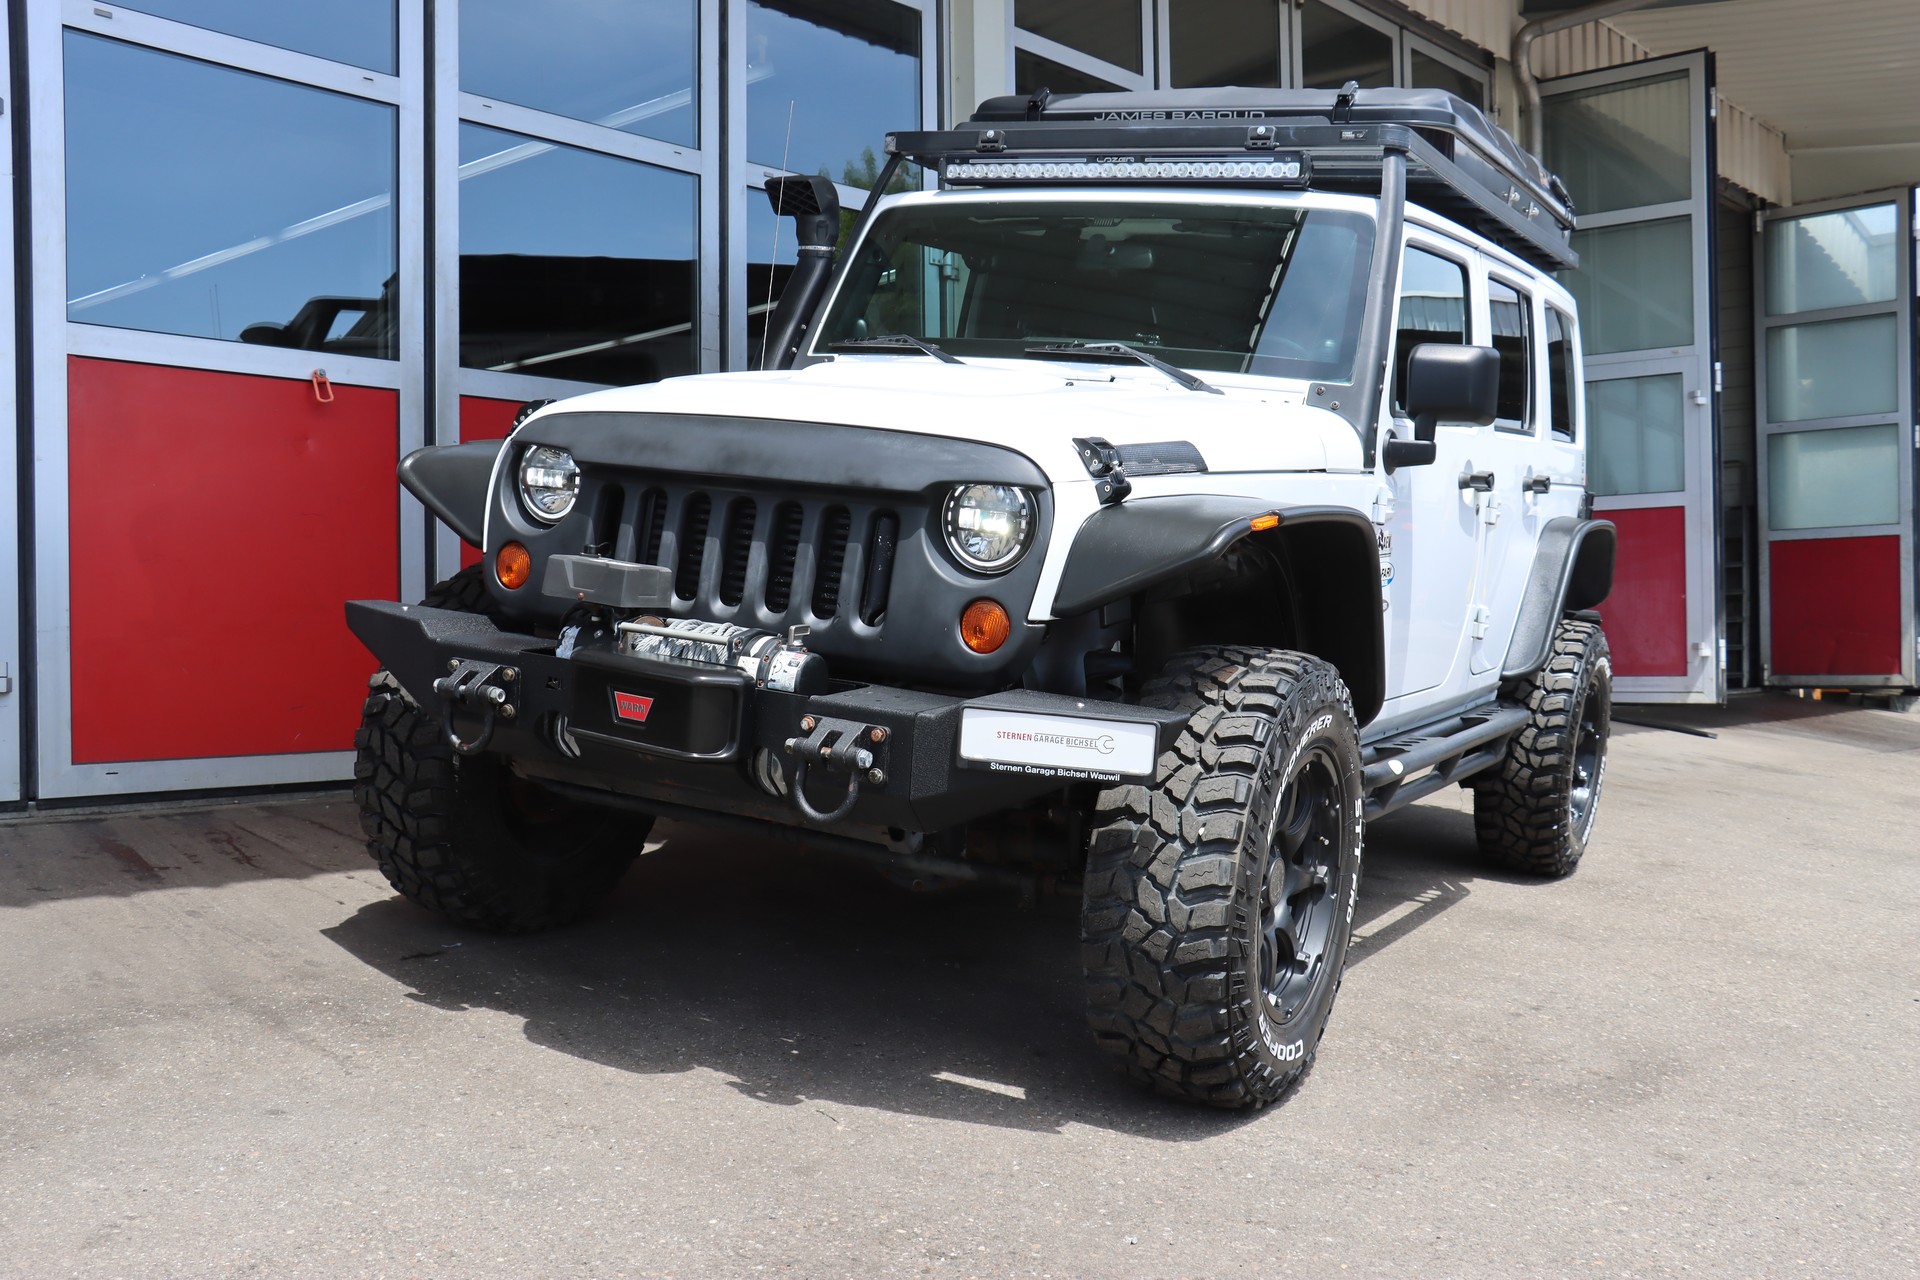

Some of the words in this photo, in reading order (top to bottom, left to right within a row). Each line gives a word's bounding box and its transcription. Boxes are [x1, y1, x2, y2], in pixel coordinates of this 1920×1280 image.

[1093, 111, 1166, 121] JAMES
[1172, 110, 1266, 120] BAROUD
[620, 701, 645, 713] WARN
[997, 731, 1032, 742] STERNEN
[1033, 733, 1065, 745] GARAGE
[1065, 737, 1099, 748] BICHSEL
[990, 762, 1023, 772] Sternen
[1025, 765, 1056, 777] Garage
[1057, 768, 1088, 779] Bichsel
[1090, 770, 1121, 782] Wauwil
[1266, 714, 1333, 847] DISCOVERER
[1355, 798, 1363, 865] STT
[1346, 872, 1357, 924] PRO
[1258, 1010, 1304, 1062] COOPER
